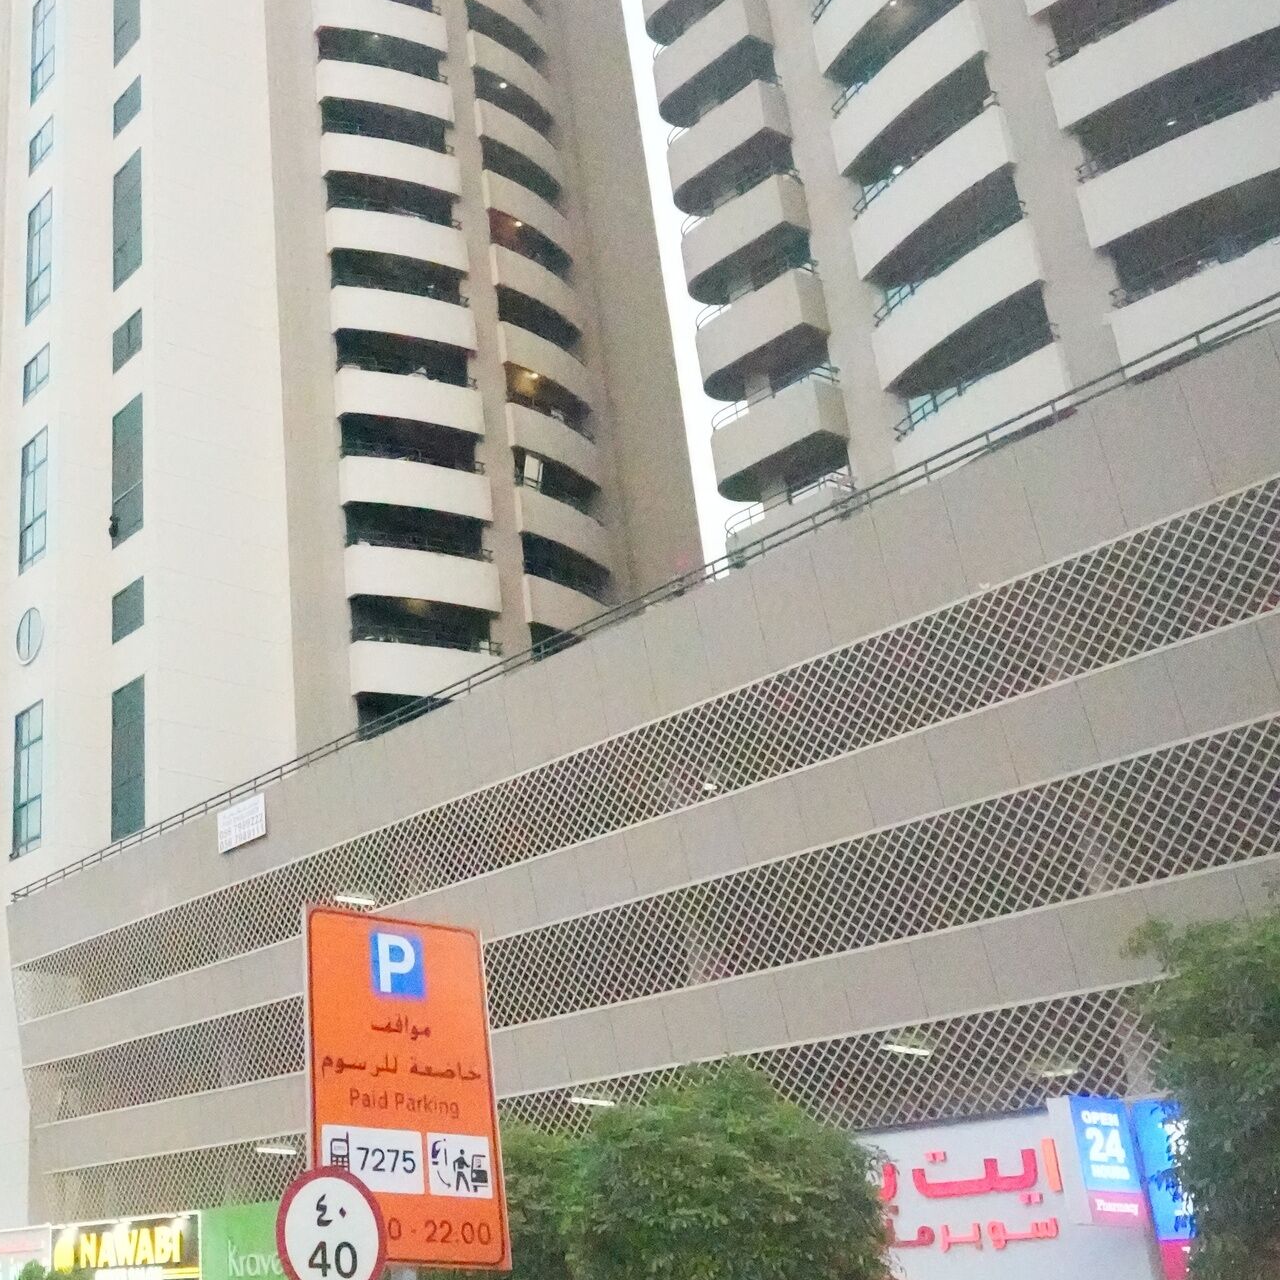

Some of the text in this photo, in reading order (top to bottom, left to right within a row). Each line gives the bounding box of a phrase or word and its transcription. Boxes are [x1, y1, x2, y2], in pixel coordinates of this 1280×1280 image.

[377, 932, 416, 993] P
[371, 1014, 432, 1041] مواقف
[321, 1052, 481, 1081] خاضعة للرسوم
[349, 1087, 459, 1119] Paid Parking
[1081, 1110, 1120, 1127] OPEN
[356, 1147, 416, 1174] 7275
[1085, 1126, 1127, 1164] 24
[316, 1194, 347, 1227] ٤٠
[1094, 1198, 1139, 1217] Pharmacy
[80, 1223, 183, 1269] NAWABI
[308, 1241, 358, 1278] 40
